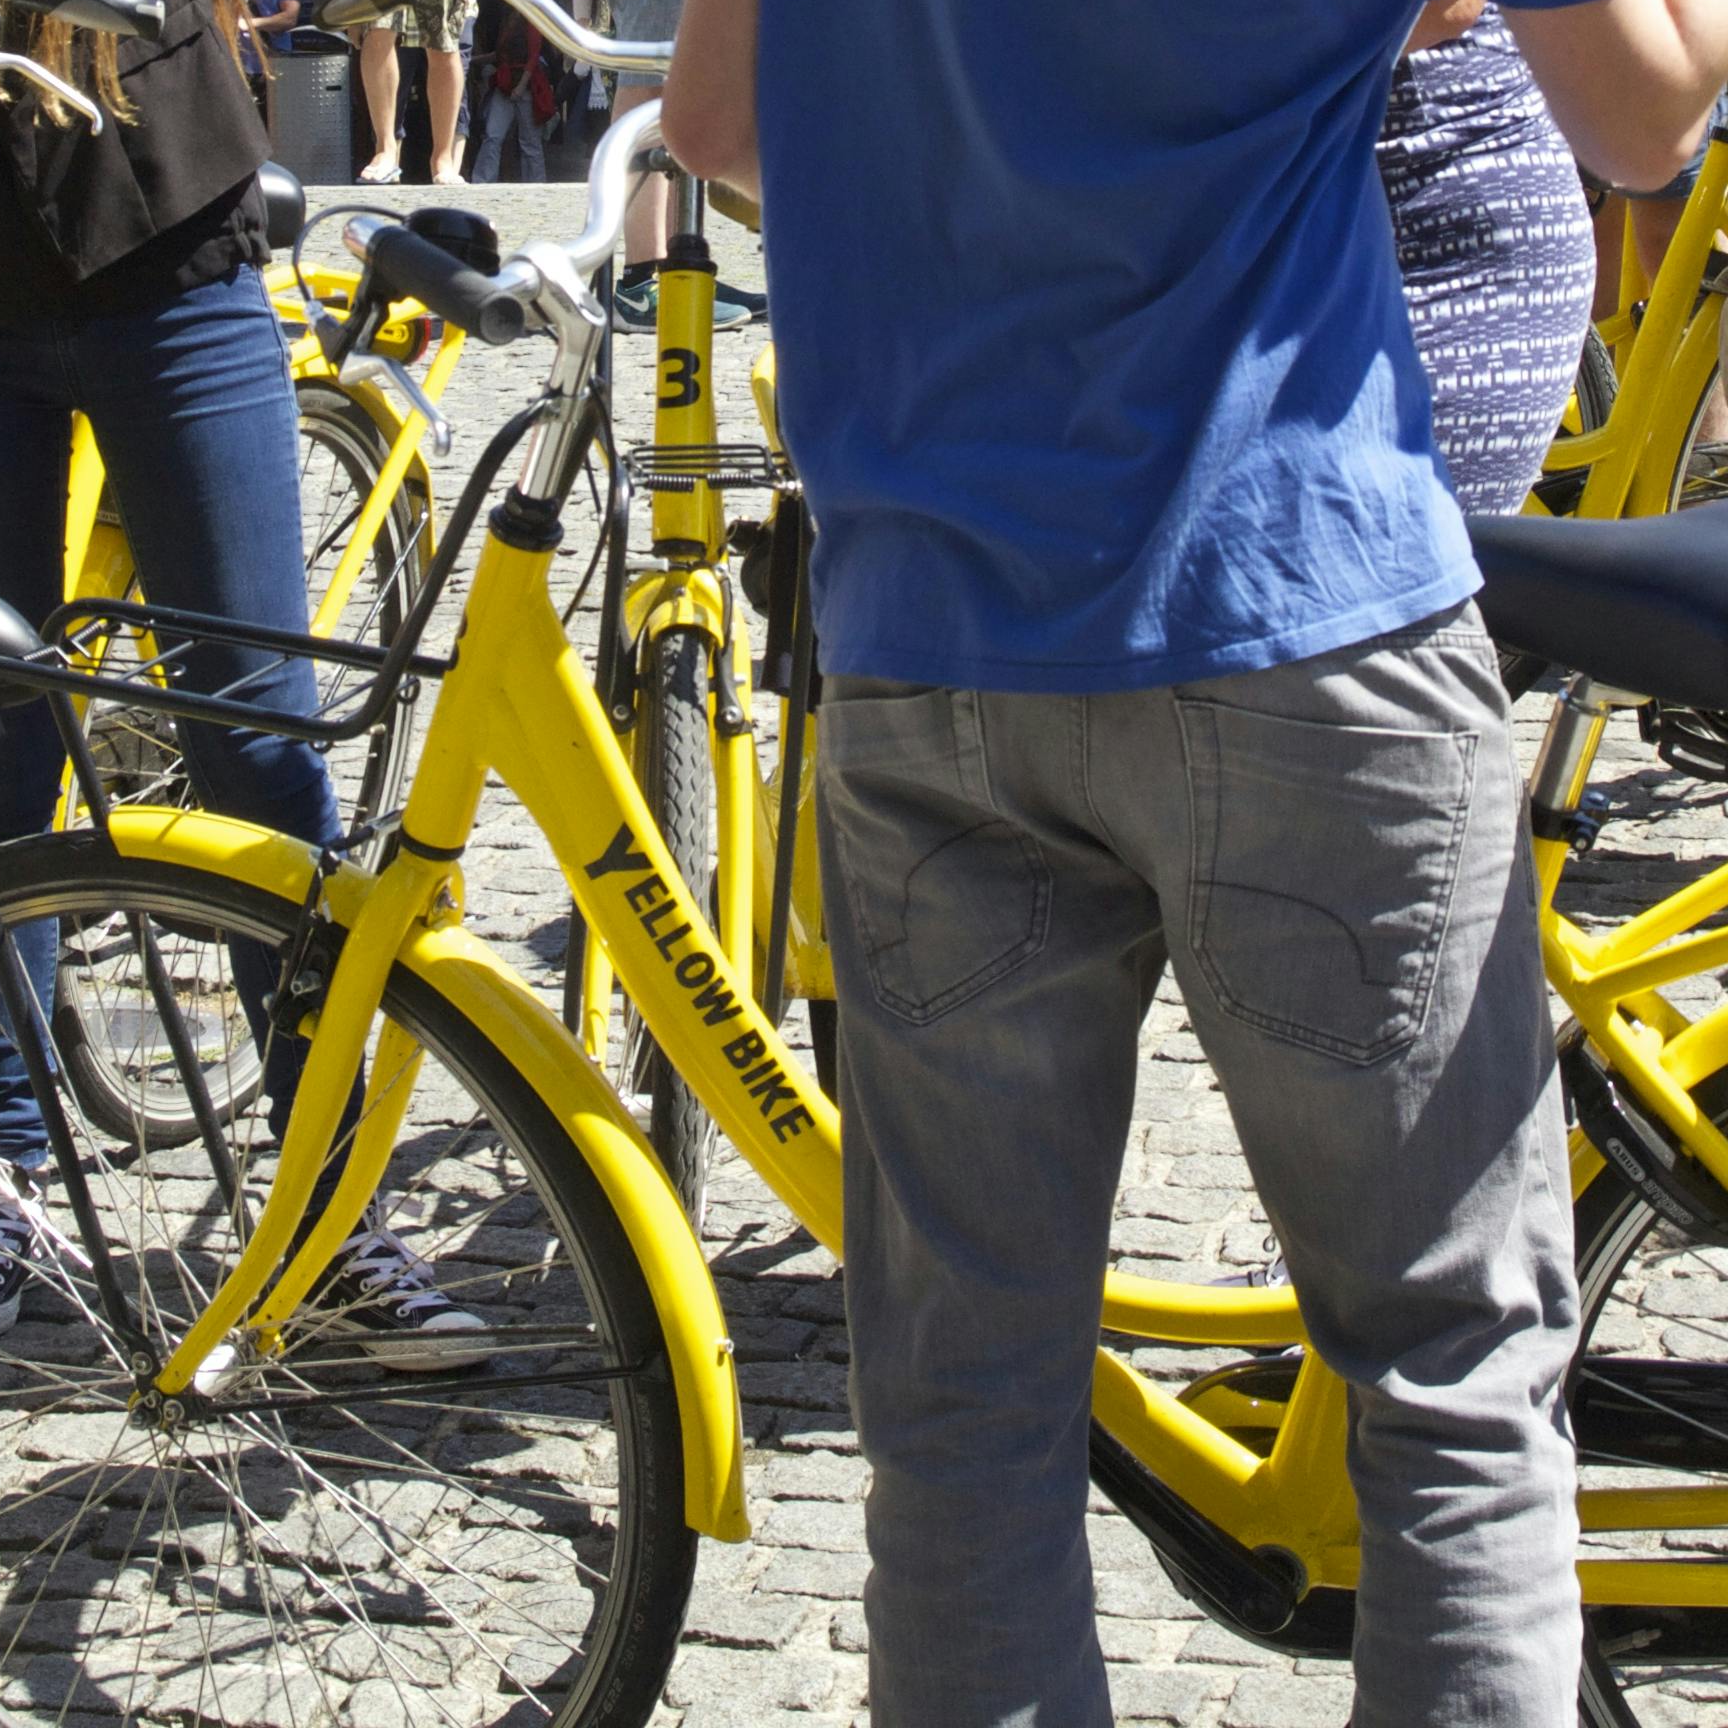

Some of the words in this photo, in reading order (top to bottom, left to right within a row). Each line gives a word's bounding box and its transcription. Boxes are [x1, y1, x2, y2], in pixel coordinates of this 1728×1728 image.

[659, 348, 701, 409] 3
[585, 821, 743, 1028] YELLOW
[722, 1028, 816, 1145] BIKE
